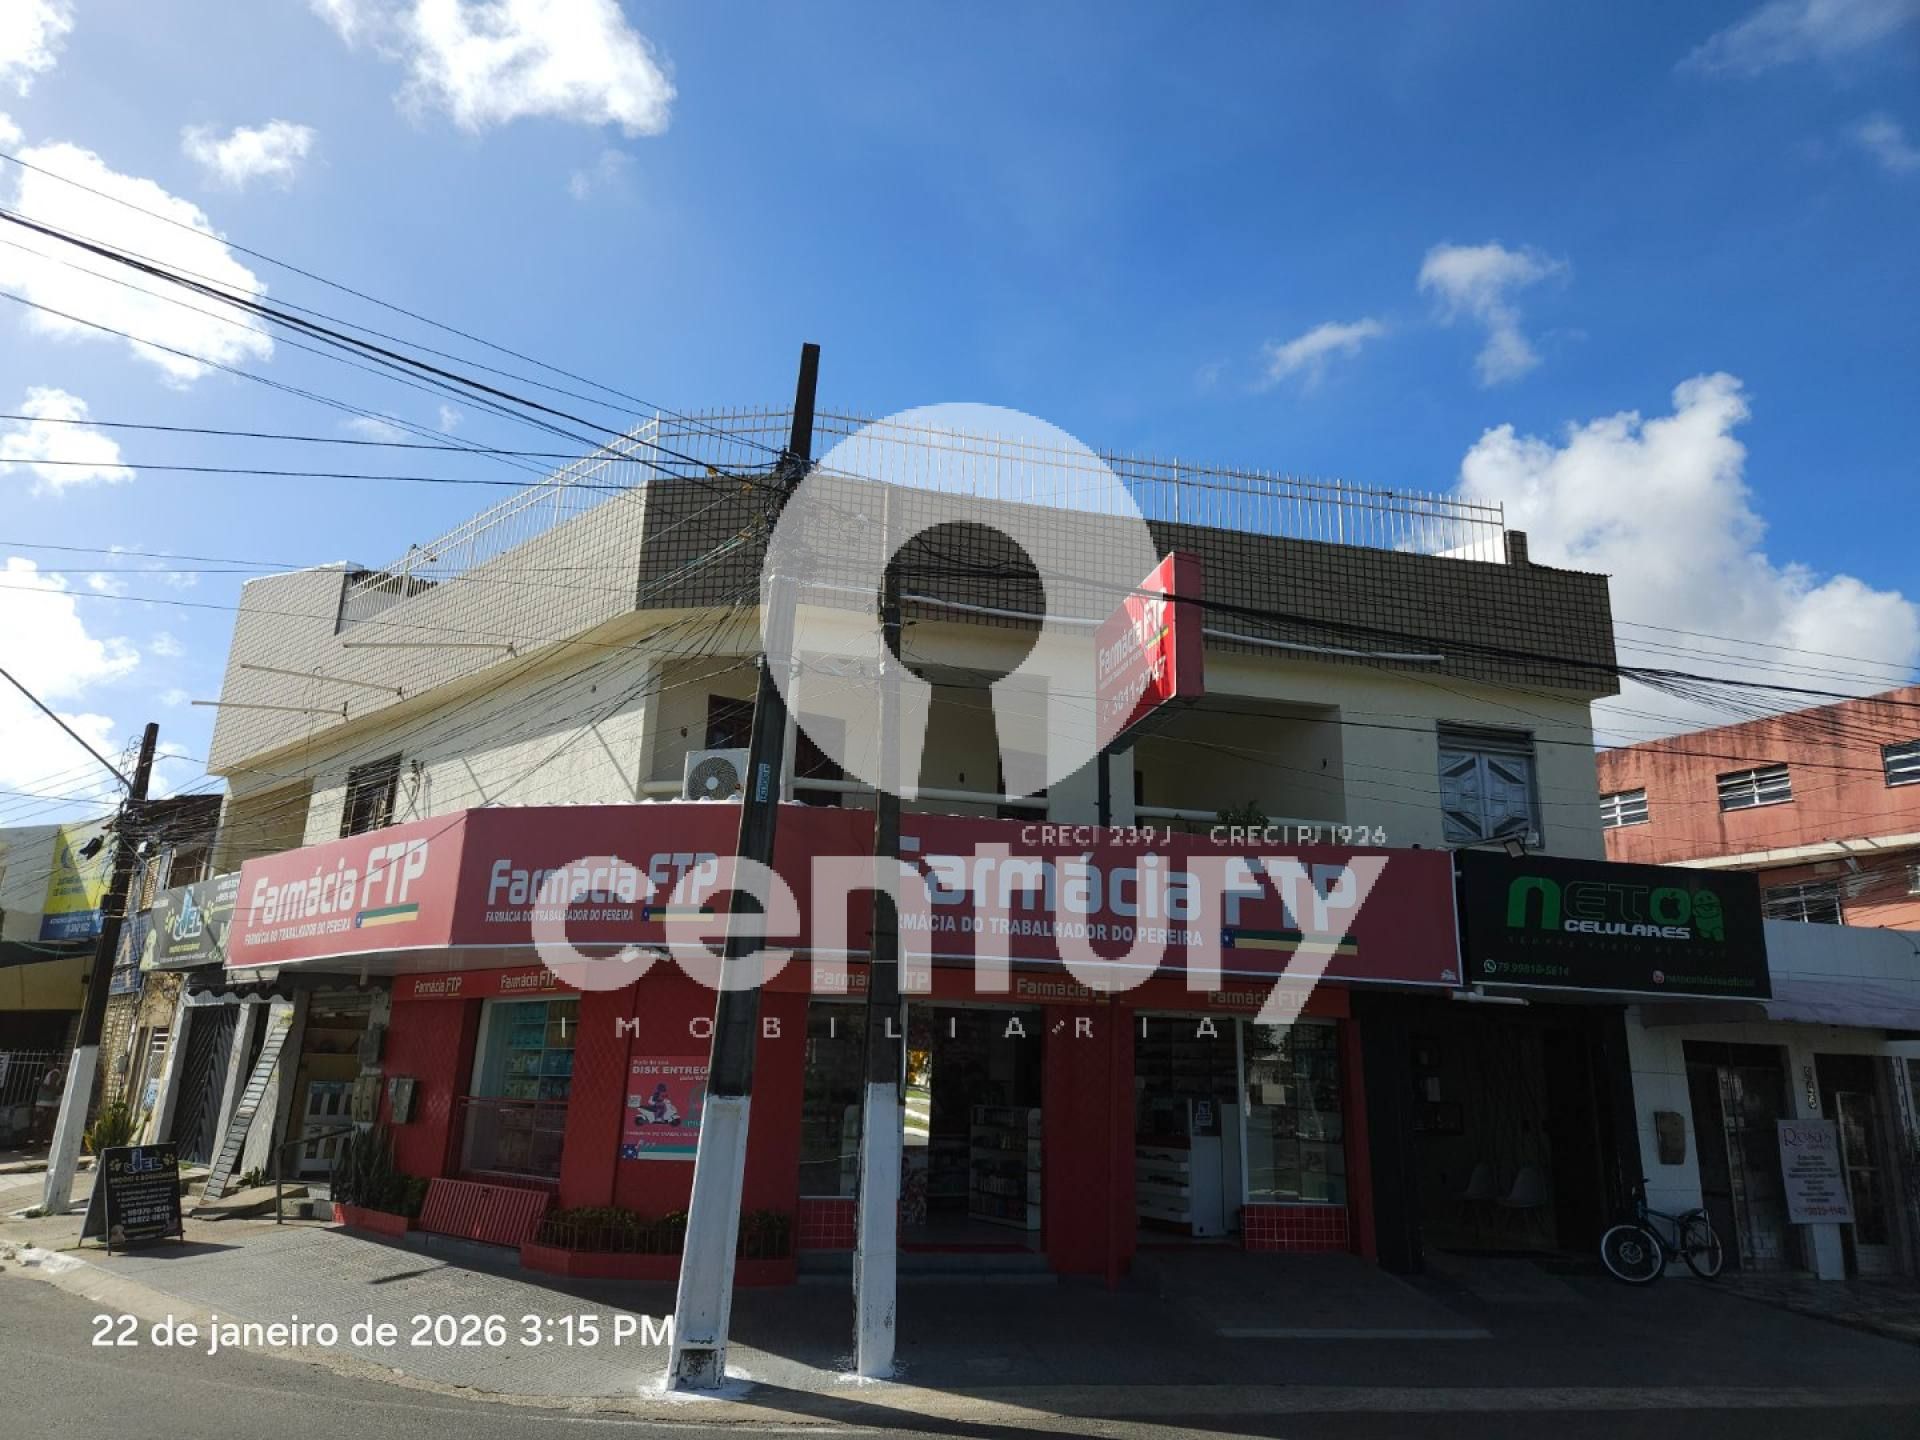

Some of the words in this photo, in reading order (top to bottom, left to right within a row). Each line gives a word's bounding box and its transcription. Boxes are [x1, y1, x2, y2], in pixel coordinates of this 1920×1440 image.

[248, 857, 358, 928] Farmácia
[361, 838, 429, 908] FTP
[488, 854, 637, 906] Farmácia
[645, 852, 719, 905] FTP
[1226, 857, 1357, 931] FTP
[522, 909, 533, 922] DO
[534, 909, 588, 922] TRABALHADOR
[589, 909, 600, 921] DO
[602, 908, 633, 921] PEREIRA
[900, 910, 956, 932] MÁCIA
[961, 915, 983, 933] DO
[989, 917, 1107, 941] TRABALHADOR
[1111, 924, 1133, 942] DO
[1138, 927, 1203, 947] PEREIRA
[1564, 919, 1691, 940] CELULARES
[814, 968, 867, 987] Farmá
[907, 971, 929, 989] TP
[1017, 977, 1089, 997] Farmácia
[1208, 988, 1275, 1005] Farmácia
[632, 1066, 659, 1075] DISK
[663, 1066, 710, 1075] ENTREG
